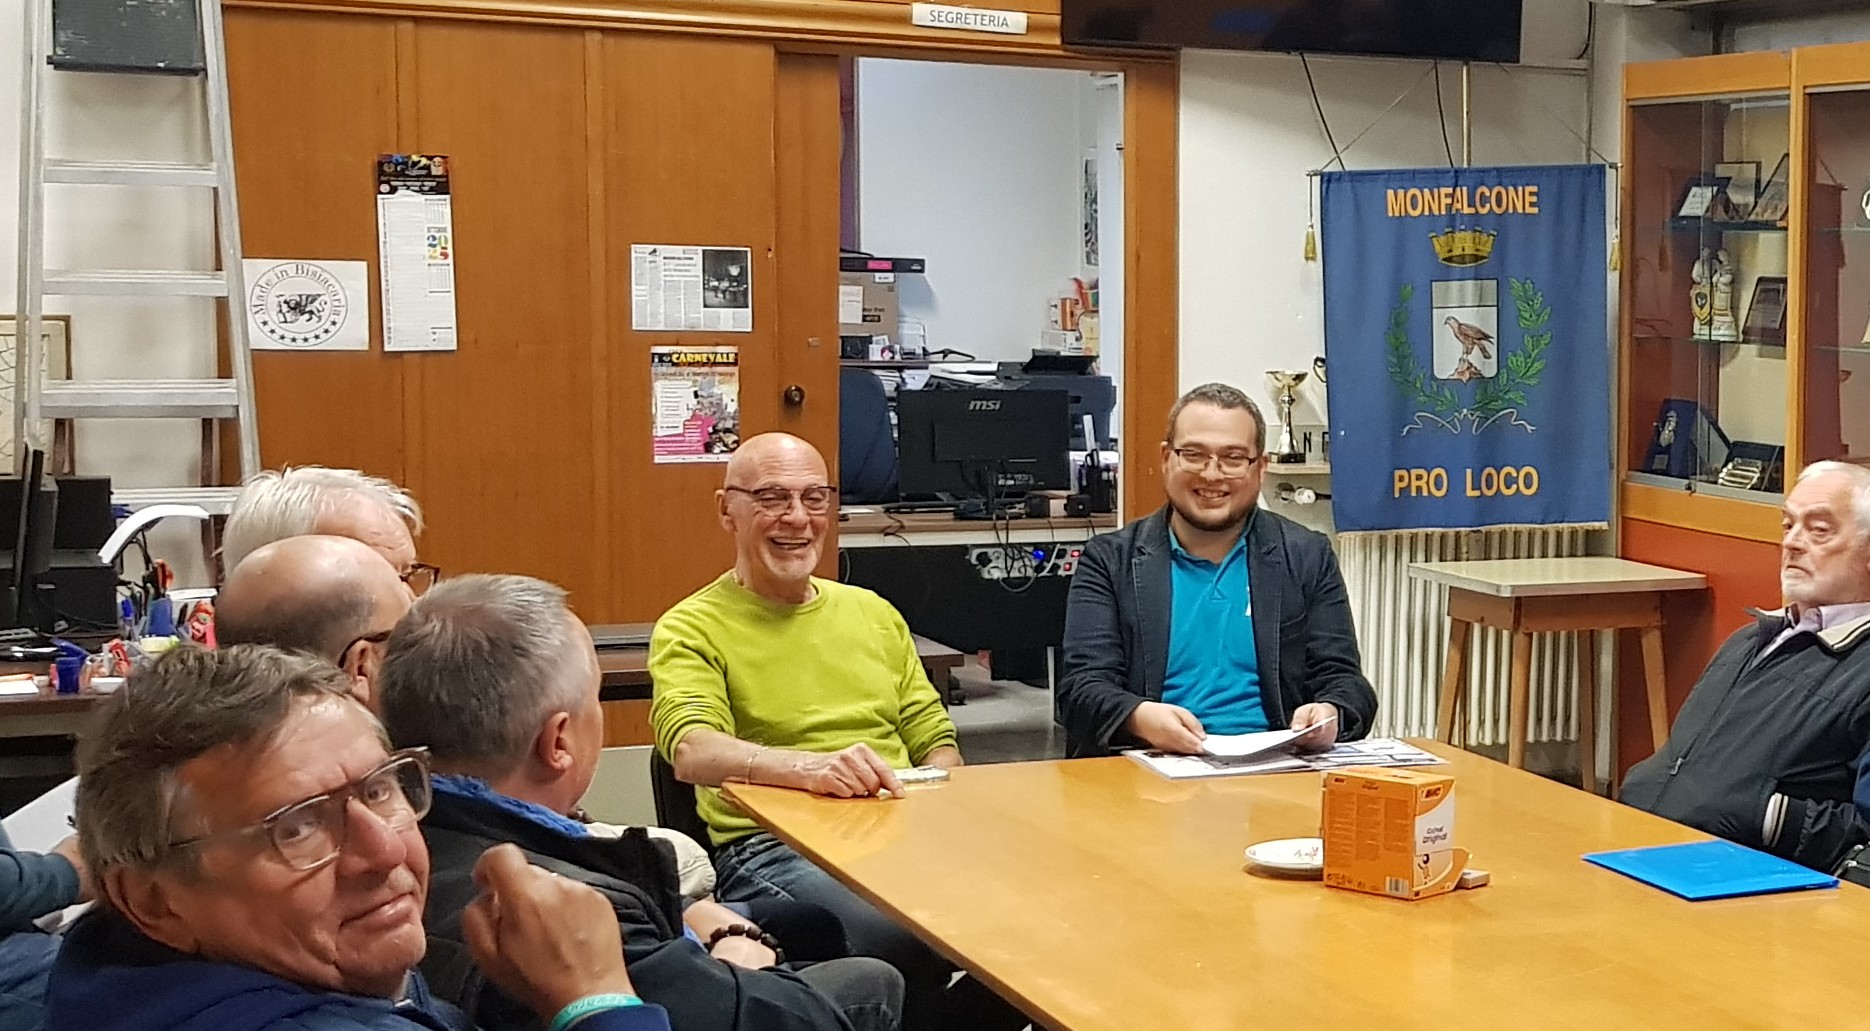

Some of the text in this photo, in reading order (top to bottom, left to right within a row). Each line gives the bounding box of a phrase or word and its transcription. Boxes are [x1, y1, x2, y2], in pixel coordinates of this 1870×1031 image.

[929, 9, 1010, 28] SEGRETERIA
[1386, 185, 1540, 217] MONFALCONE
[252, 278, 273, 315] Made
[275, 268, 289, 281] in
[671, 353, 736, 362] CARNEVALE
[968, 399, 1003, 411] msi
[1393, 465, 1539, 498] PRO LOCO
[1425, 787, 1441, 798] BIC
